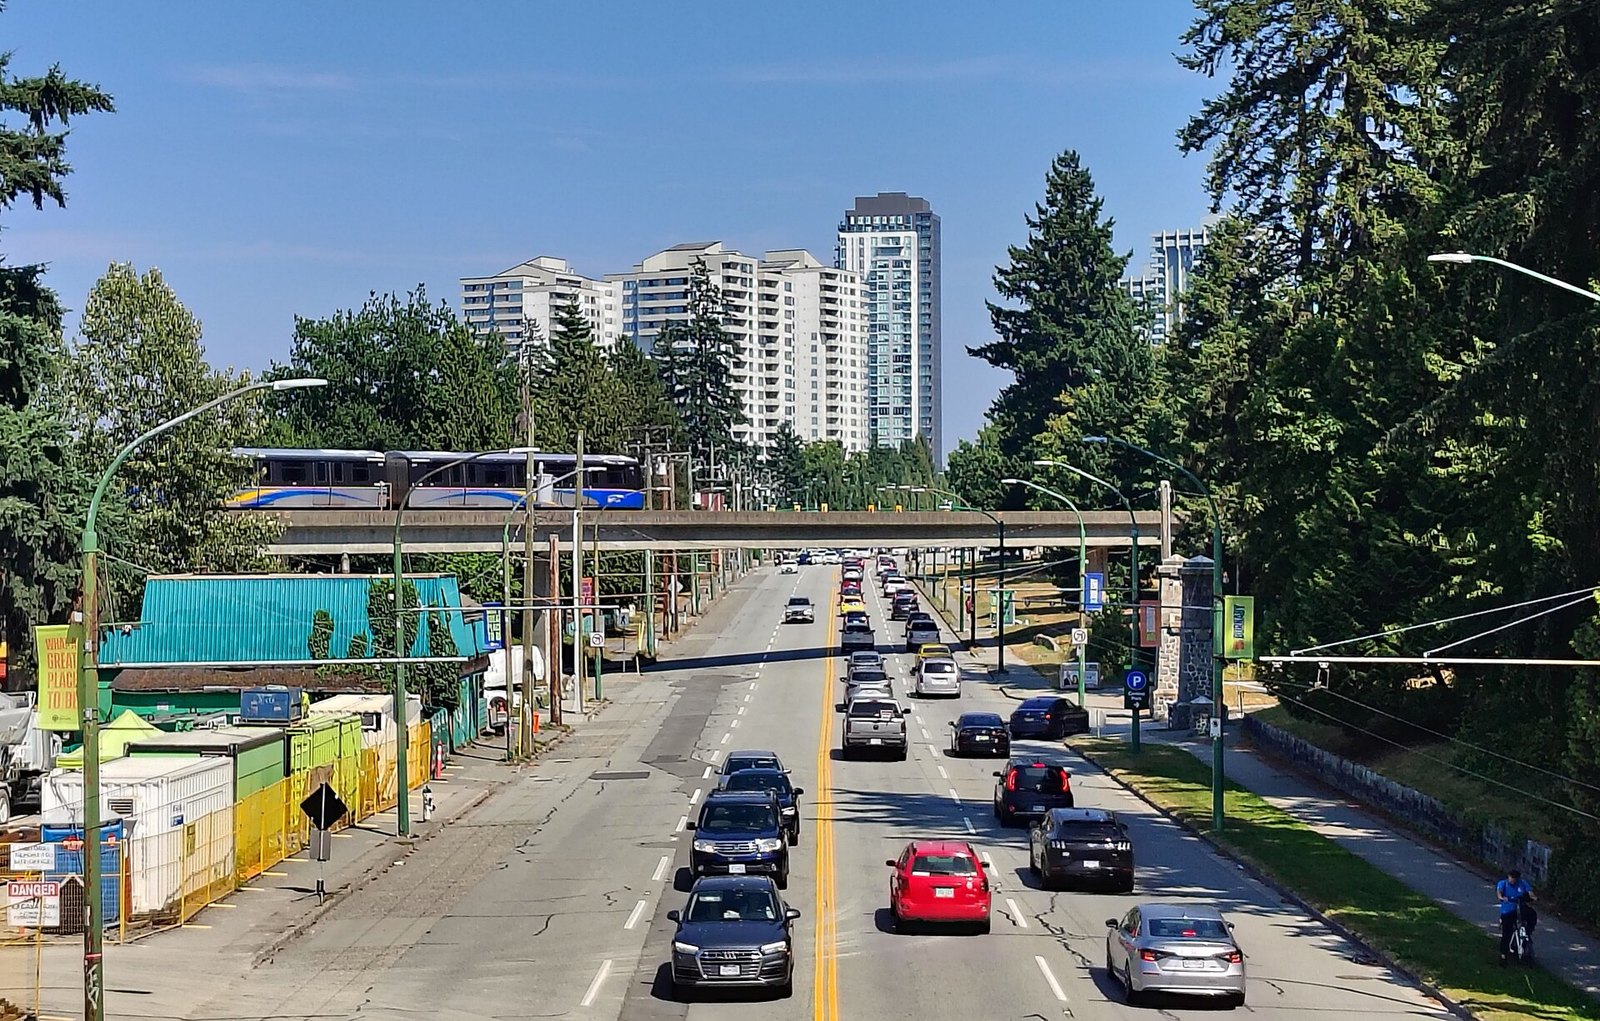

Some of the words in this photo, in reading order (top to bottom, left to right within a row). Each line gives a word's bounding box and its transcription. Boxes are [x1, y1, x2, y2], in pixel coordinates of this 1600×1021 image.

[47, 652, 76, 669] GREAT
[1133, 676, 1142, 687] P
[47, 691, 60, 709] TO
[11, 883, 56, 896] DANGER
